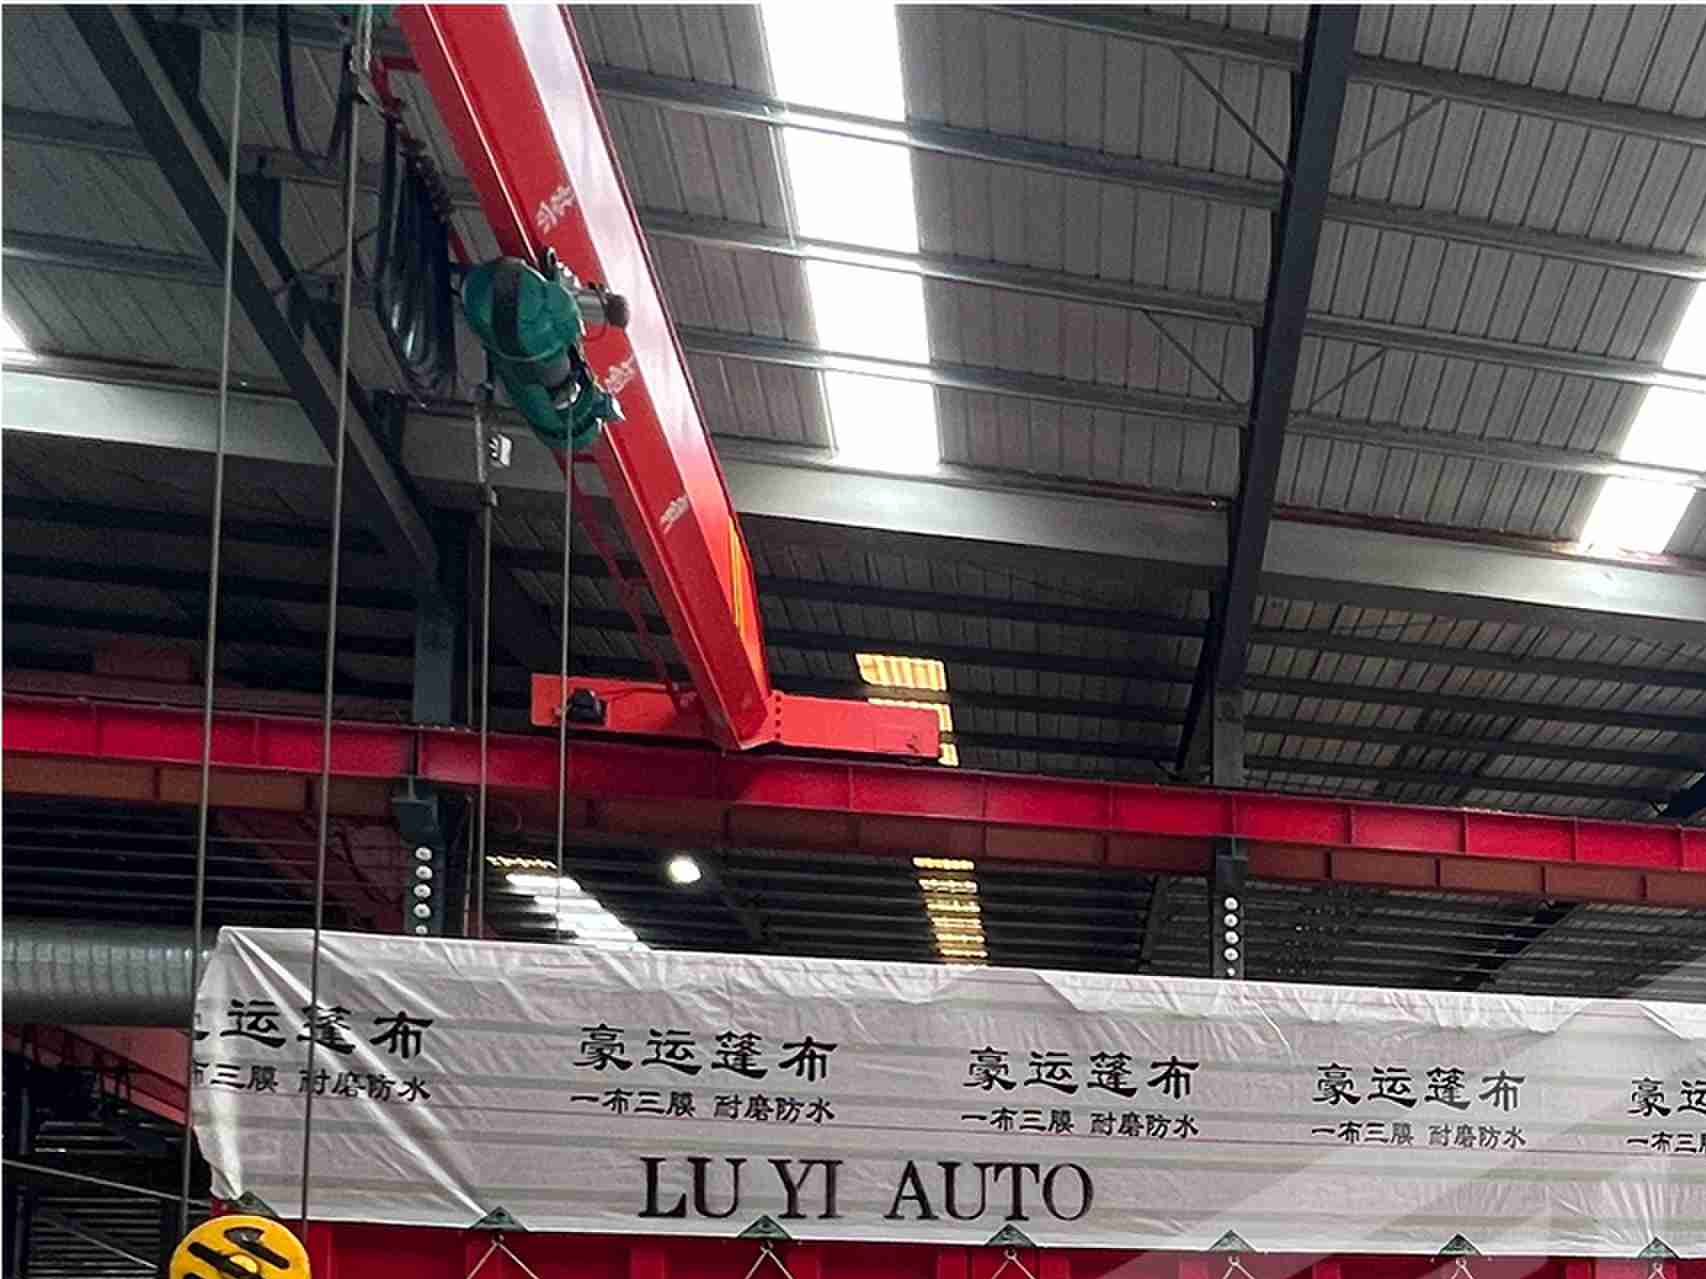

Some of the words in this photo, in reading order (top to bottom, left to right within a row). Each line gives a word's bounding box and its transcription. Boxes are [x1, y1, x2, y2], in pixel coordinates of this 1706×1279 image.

[192, 998, 434, 1060] 运篷布
[574, 1024, 837, 1081] 豪运篷布
[964, 1046, 1199, 1099] 豪运篷布
[1313, 1063, 1524, 1111] 豪运篷布
[571, 1088, 695, 1117] 一布三膜
[714, 1094, 834, 1123] 耐磨防水
[962, 1107, 1074, 1134] 一布三膜
[1091, 1112, 1198, 1139] 耐磨防水
[1312, 1121, 1414, 1144] 一布三膜
[1429, 1123, 1525, 1149] 耐磨防水
[638, 1157, 747, 1219] LU
[766, 1158, 844, 1220] YI
[885, 1160, 1094, 1221] AUTO
